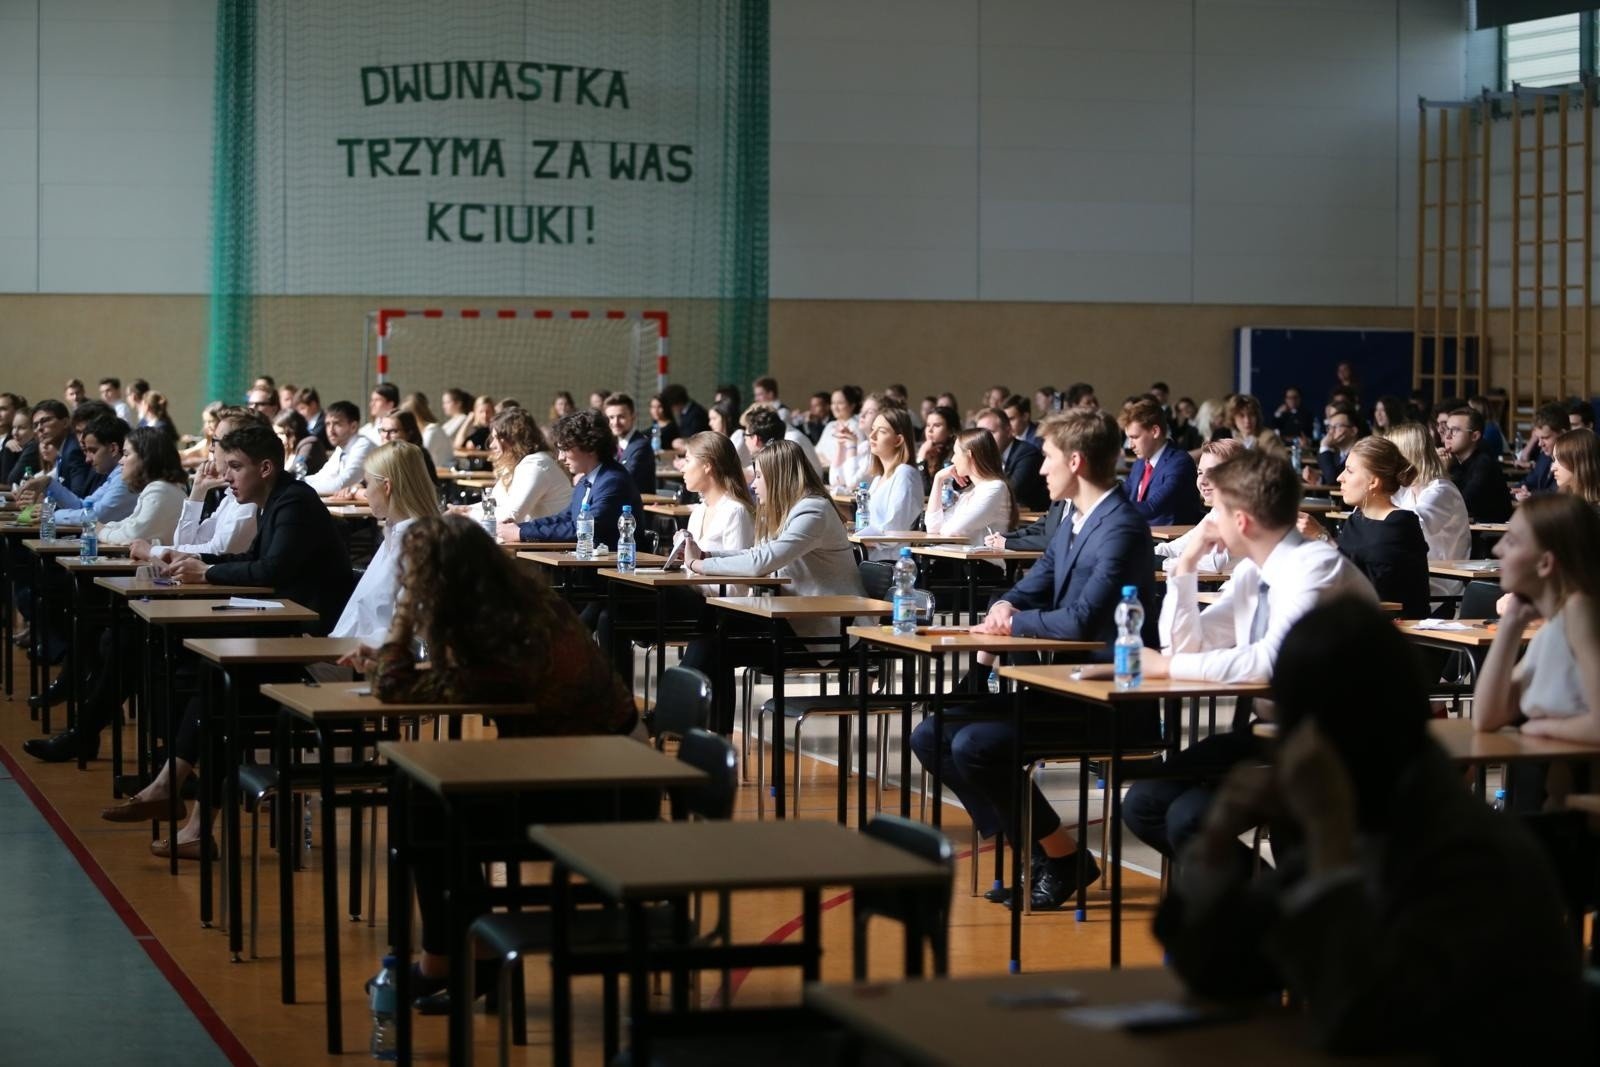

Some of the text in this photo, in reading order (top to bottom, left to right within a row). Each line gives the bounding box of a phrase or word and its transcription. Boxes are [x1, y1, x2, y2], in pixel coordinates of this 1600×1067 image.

[360, 60, 630, 109] DWUNASTKA
[337, 137, 694, 183] TRZYMA ZA WAS
[427, 202, 595, 244] KCIUKI!
